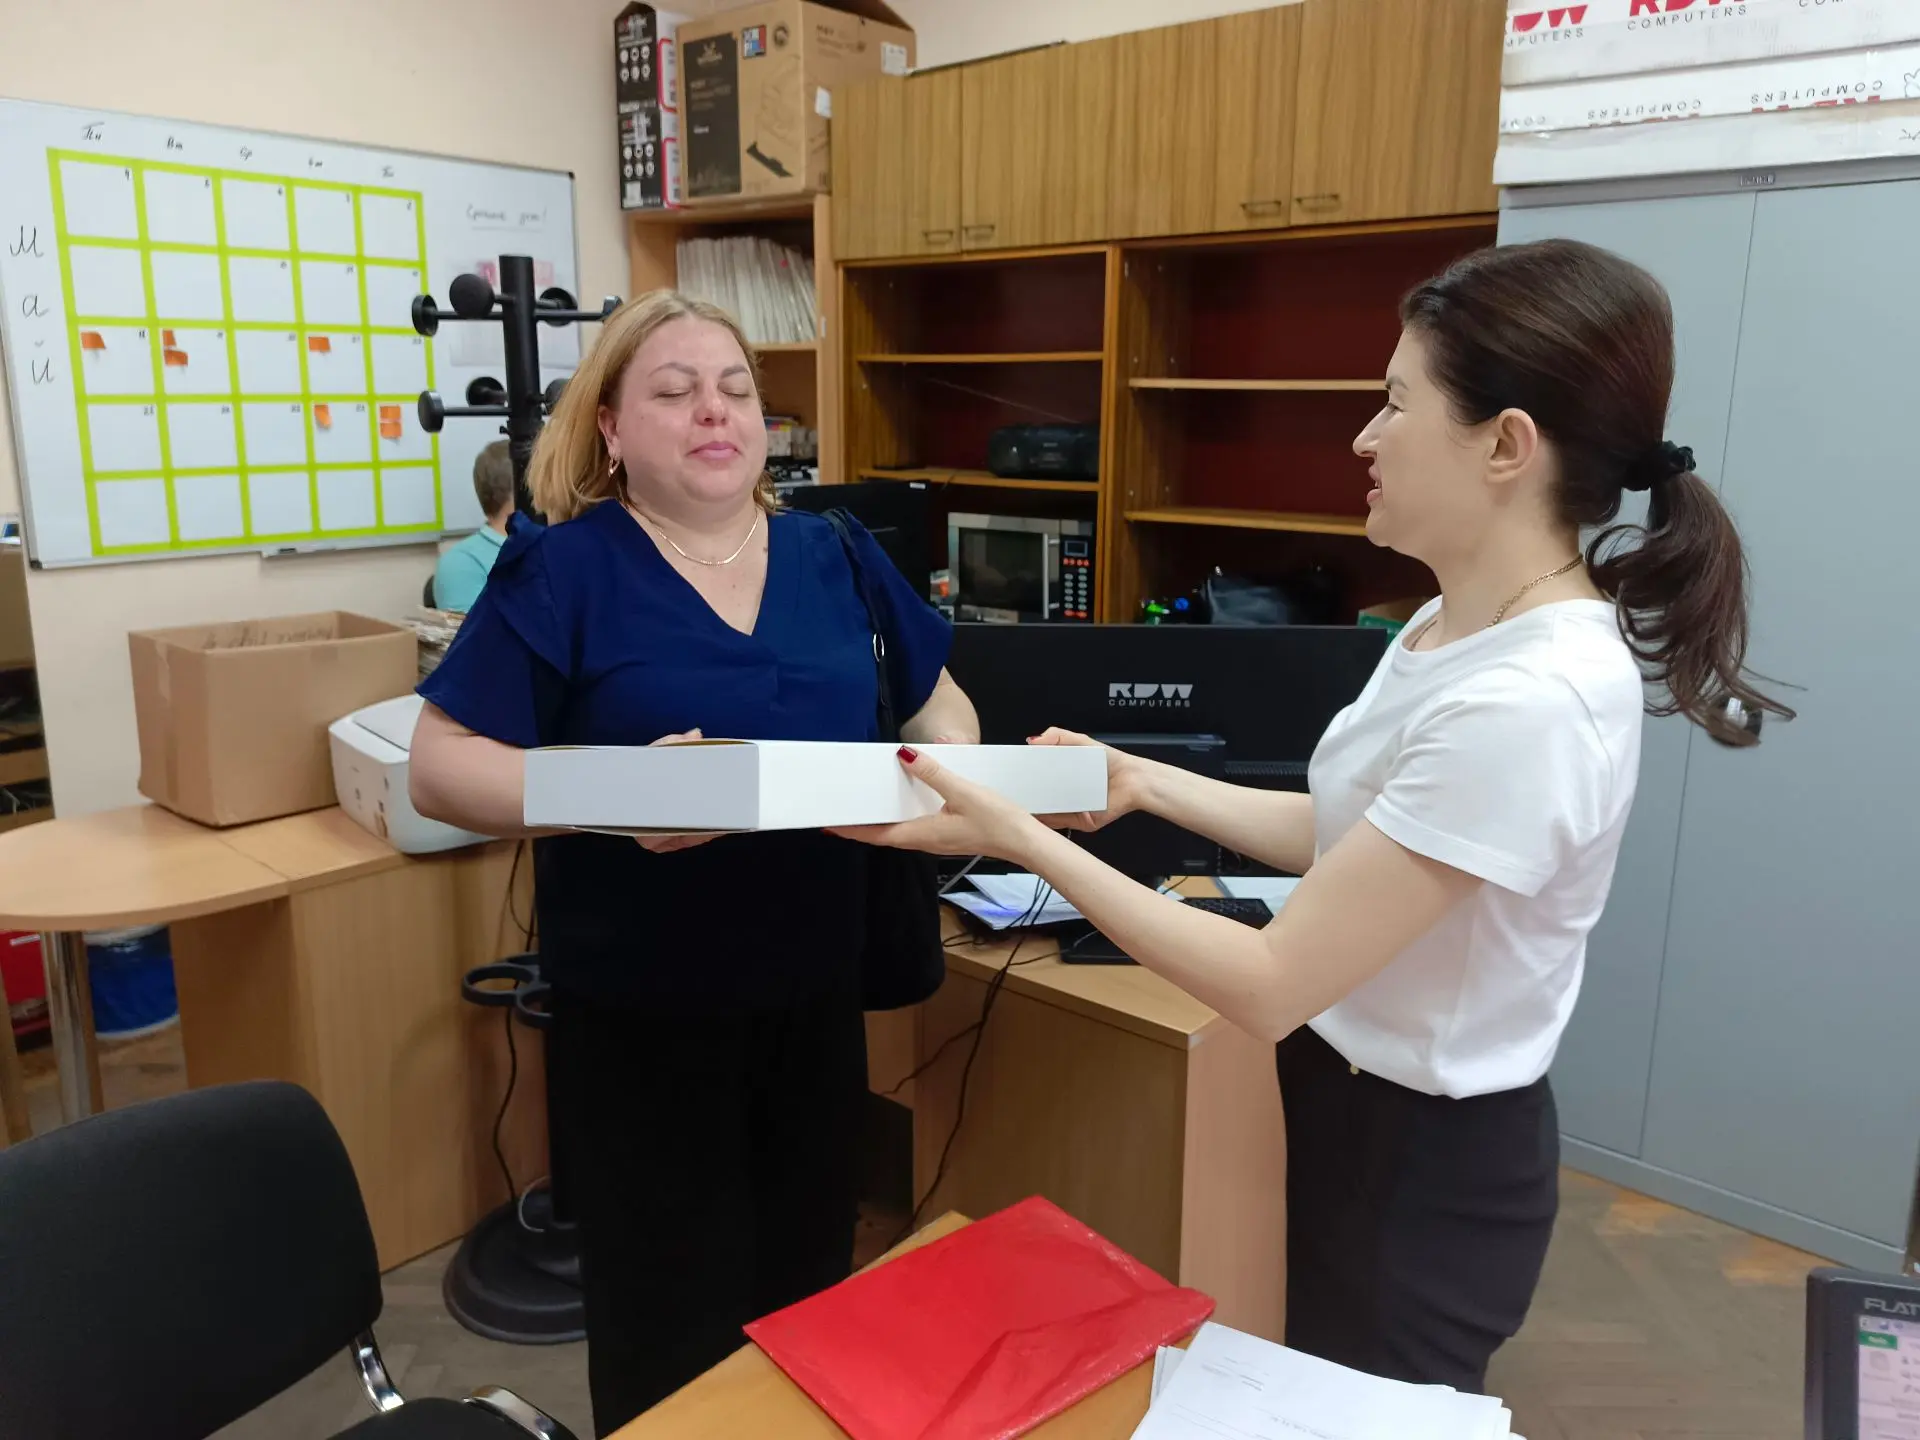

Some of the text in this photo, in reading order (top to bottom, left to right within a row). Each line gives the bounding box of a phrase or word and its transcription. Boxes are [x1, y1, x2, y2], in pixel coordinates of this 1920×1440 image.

[1627, 4, 1747, 31] COMPUTERS
[1751, 80, 1883, 104] COMPUTERS
[1587, 99, 1701, 119] COMPUTERS
[1108, 682, 1194, 699] RDW
[1108, 698, 1191, 708] COMPUTERS
